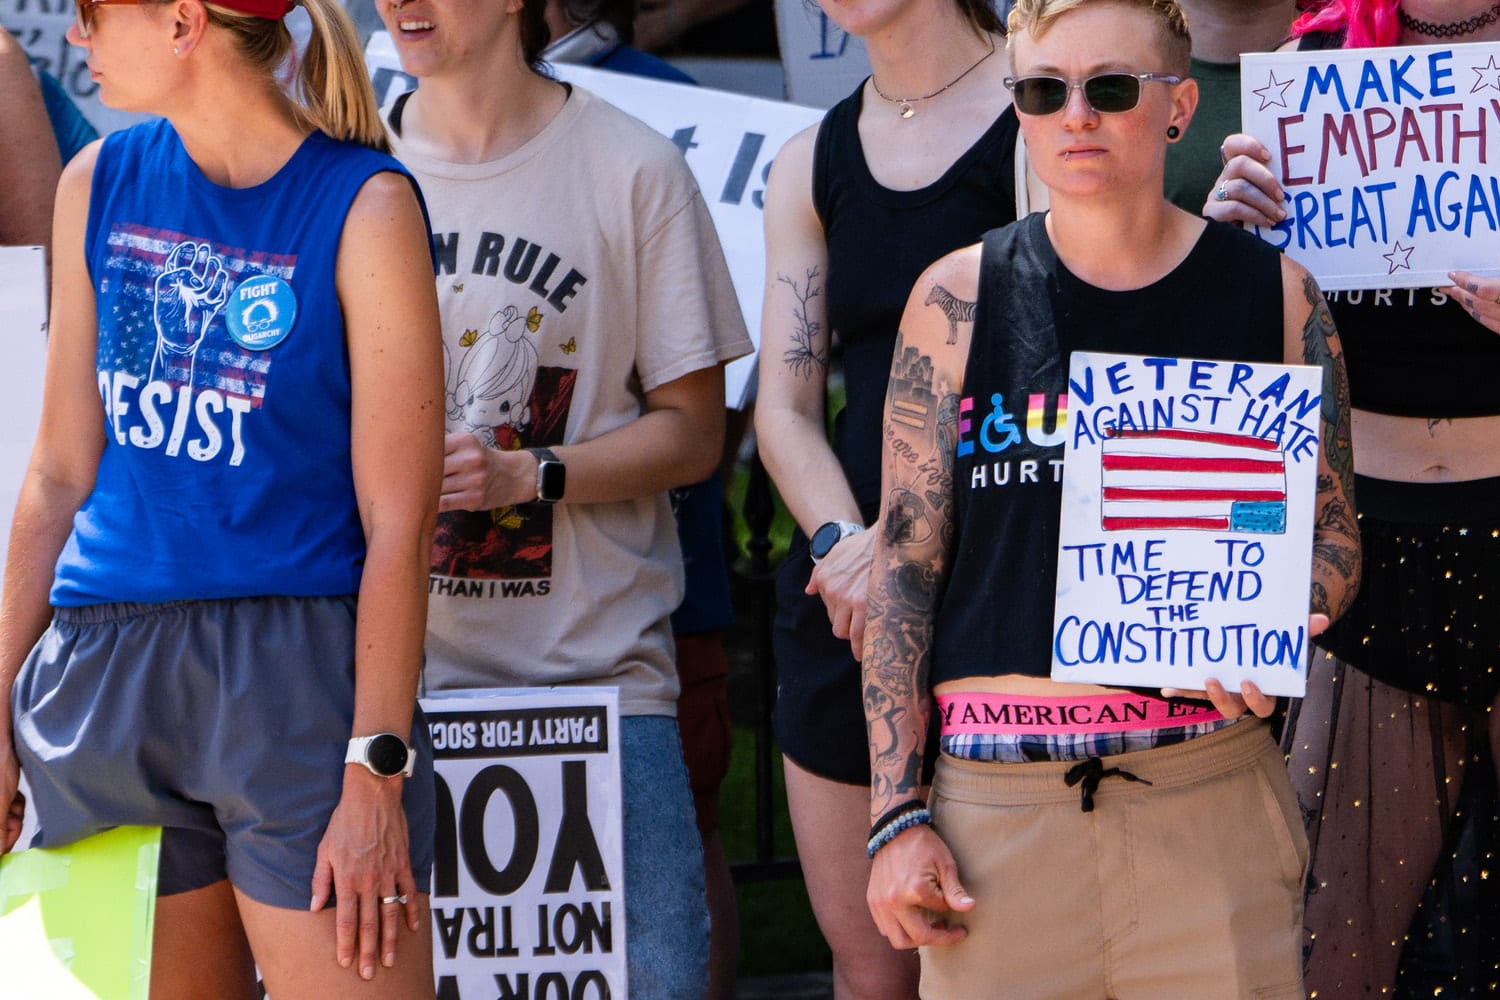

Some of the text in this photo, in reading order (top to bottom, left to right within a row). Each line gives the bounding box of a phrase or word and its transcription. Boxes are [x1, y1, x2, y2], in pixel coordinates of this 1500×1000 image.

[1300, 50, 1456, 113] MAKE
[471, 231, 588, 314] RULE
[240, 281, 278, 301] FIGHT
[242, 327, 281, 341] OLIGARCHY
[1069, 357, 1321, 420] VETERAN
[1072, 393, 1320, 464] AGAINST HATE
[1062, 538, 1266, 581] TIME TO
[429, 576, 551, 598] THAN I WAS
[1115, 570, 1263, 605] DEFEND
[1146, 602, 1200, 625] THE
[1054, 614, 1306, 670] CONSTITUTION
[960, 700, 1150, 726] AMERICAN
[480, 720, 524, 748] FOR
[529, 716, 599, 746] PARTY
[533, 901, 613, 957] NOT
